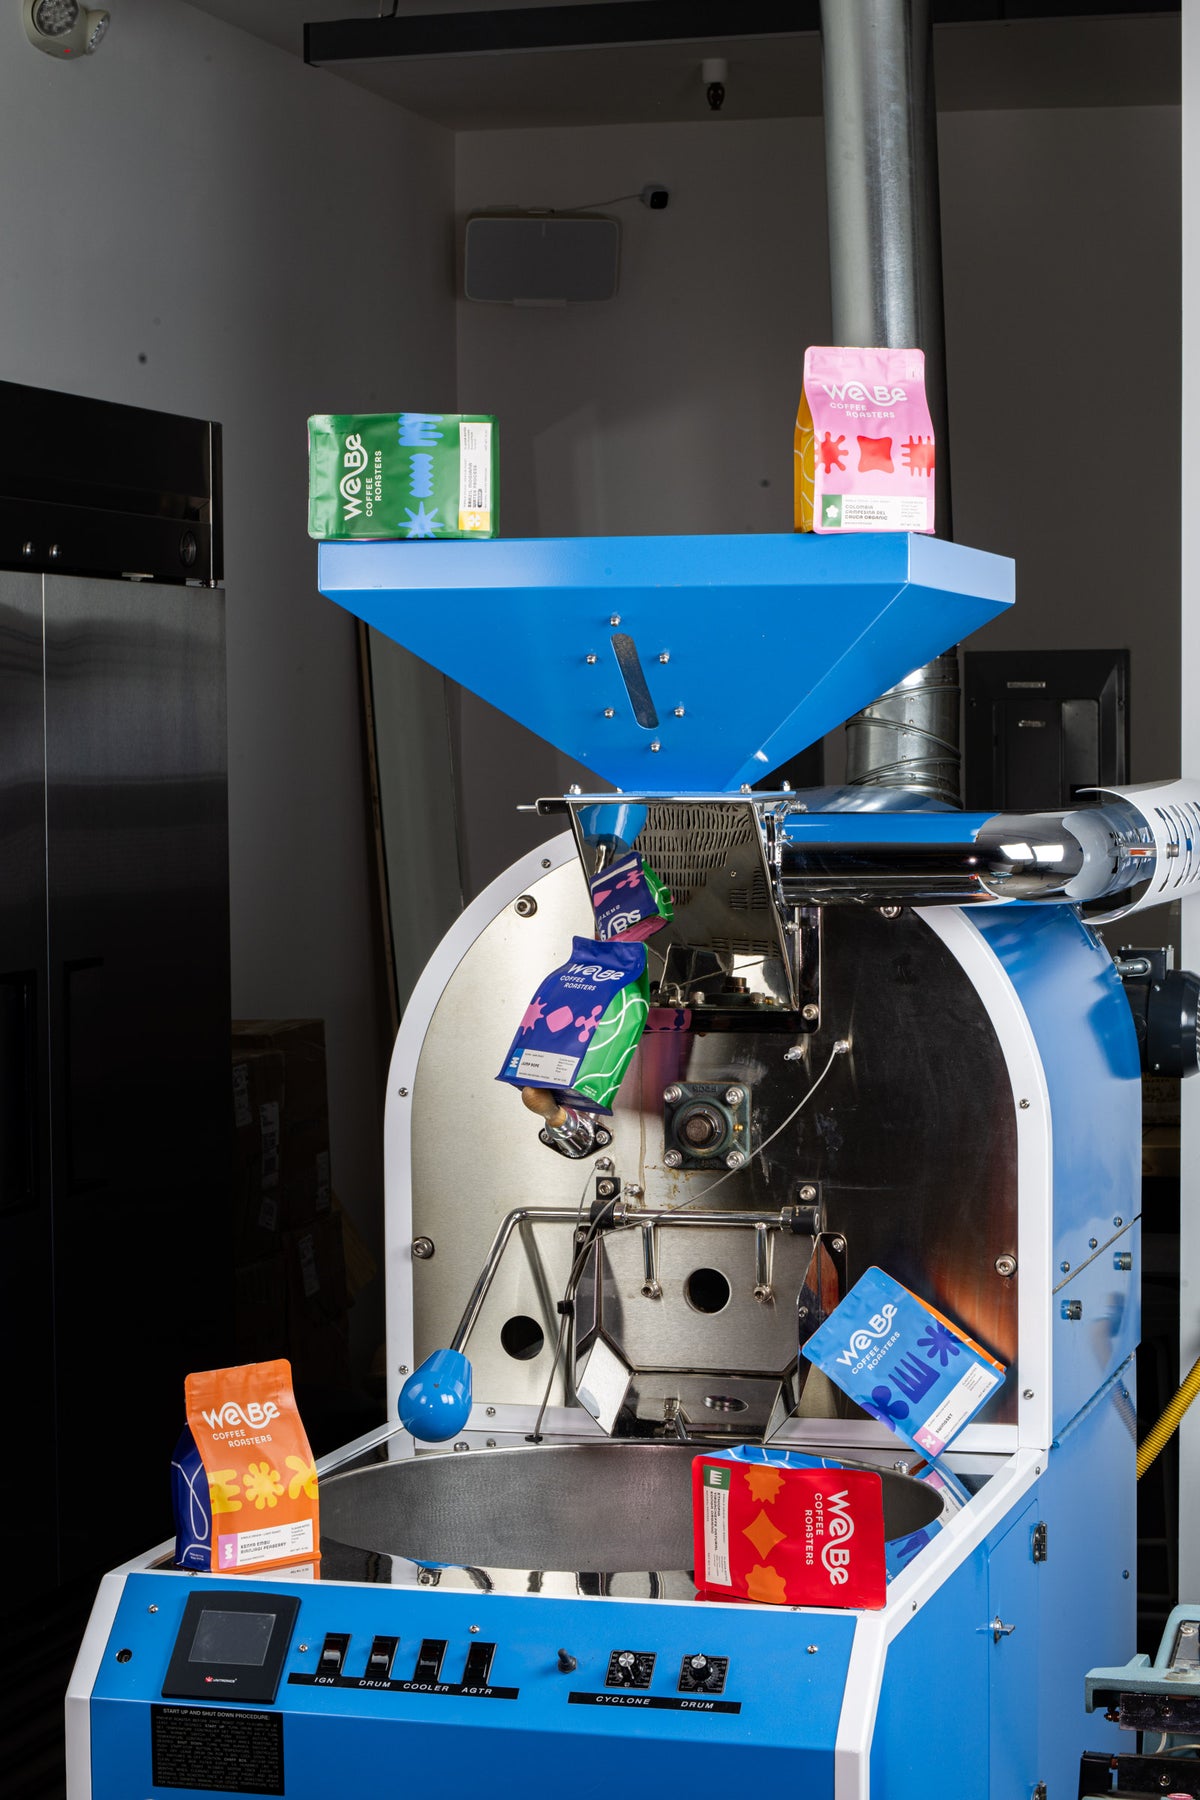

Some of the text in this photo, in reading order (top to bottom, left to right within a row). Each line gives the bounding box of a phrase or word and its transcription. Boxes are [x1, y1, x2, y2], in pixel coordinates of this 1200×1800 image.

[829, 402, 867, 410] COFFEE
[846, 410, 896, 418] ROASTERS
[564, 982, 596, 991] ROASTERS
[867, 1331, 900, 1371] ROASTERS
[851, 1345, 880, 1375] COFFEE
[212, 1429, 246, 1441] COFFEE
[228, 1434, 273, 1448] ROASTERS
[814, 1492, 824, 1536] COFFEE
[804, 1509, 814, 1566] ROASTERS
[358, 1679, 392, 1688] DRUM
[403, 1683, 450, 1692] COOLER
[461, 1686, 493, 1695] AGTR
[595, 1696, 715, 1710] CYCLONE DRUM
